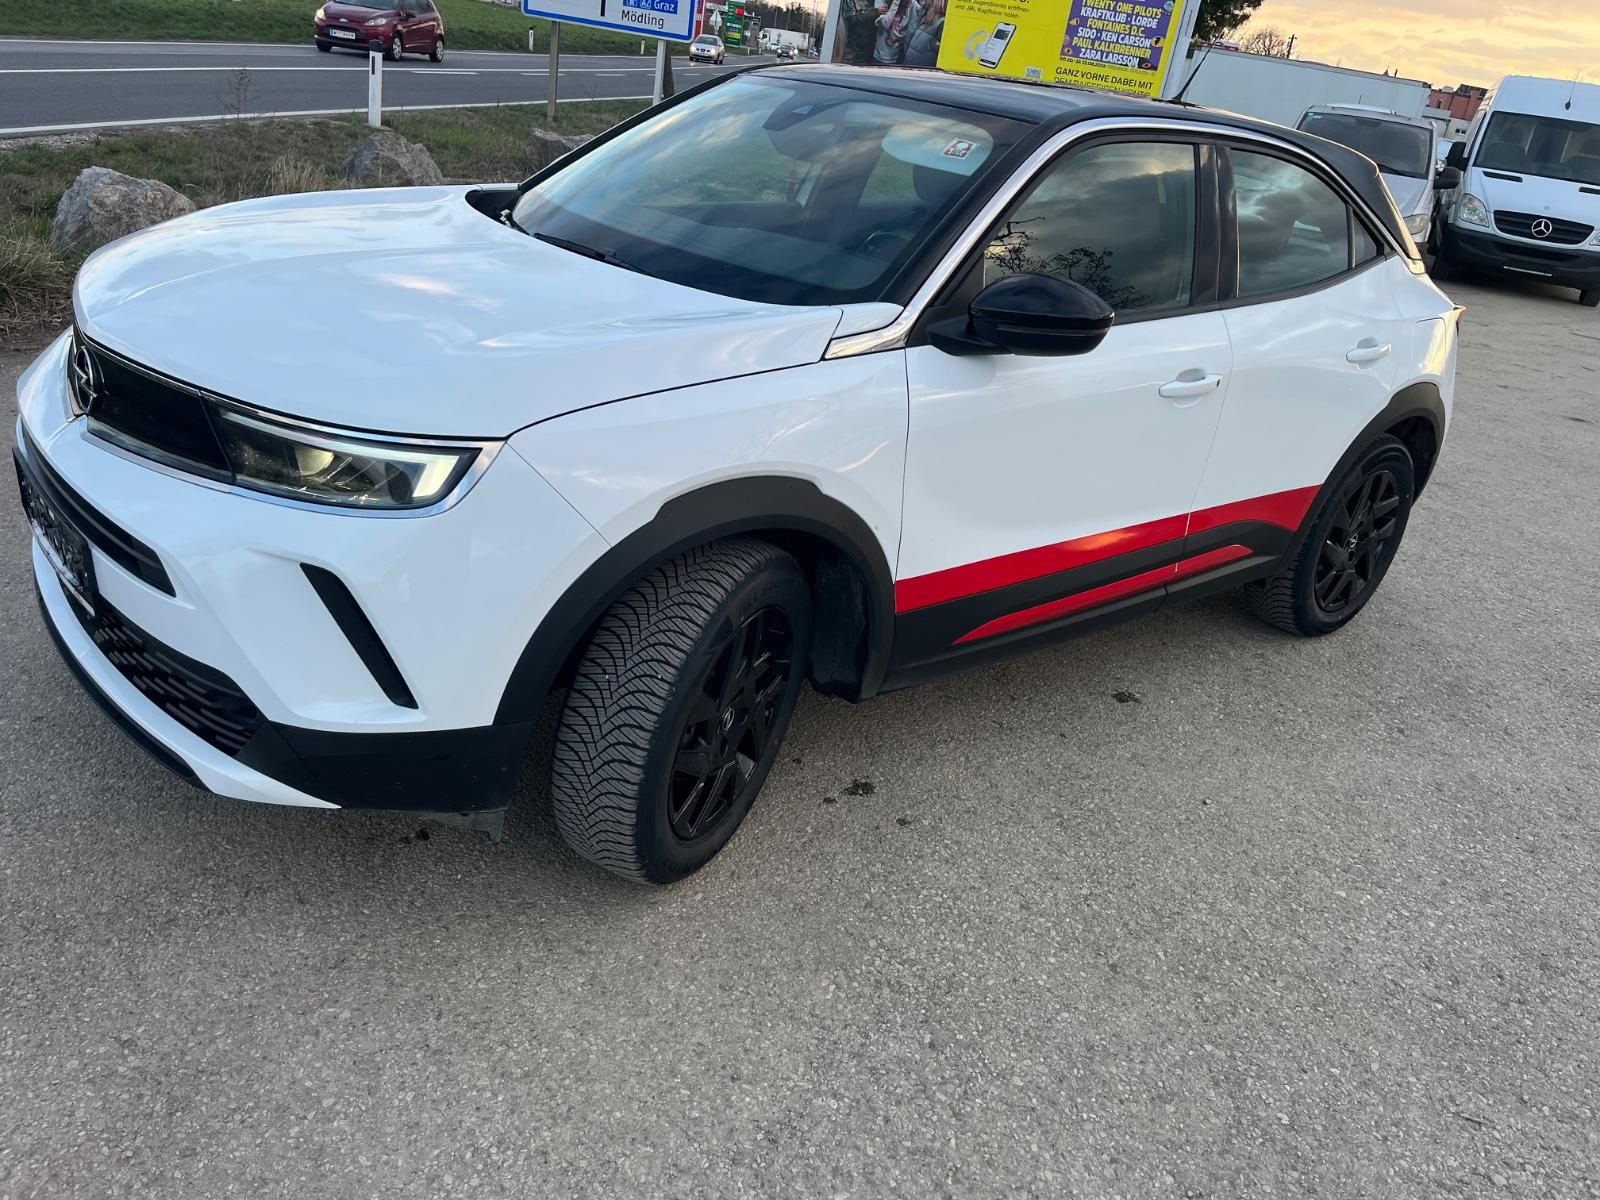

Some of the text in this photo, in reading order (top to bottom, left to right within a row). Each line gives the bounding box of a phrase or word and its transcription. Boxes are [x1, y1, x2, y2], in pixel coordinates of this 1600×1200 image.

[653, 0, 675, 12] Graz
[1082, 0, 1162, 18] TWENTY ONE PILOTS
[621, 9, 664, 29] Mödling
[1080, 6, 1159, 28] KRAFTKLUB LORDE
[1077, 27, 1152, 48] SIDO KEN CARSON
[1087, 18, 1146, 37] FONTAINES D.C.
[1072, 36, 1152, 59] PAUL KALKBRENNER
[1079, 48, 1140, 68] ZARA LARSSON
[1055, 66, 1154, 90] GANZ VORNE DABEI MIT
